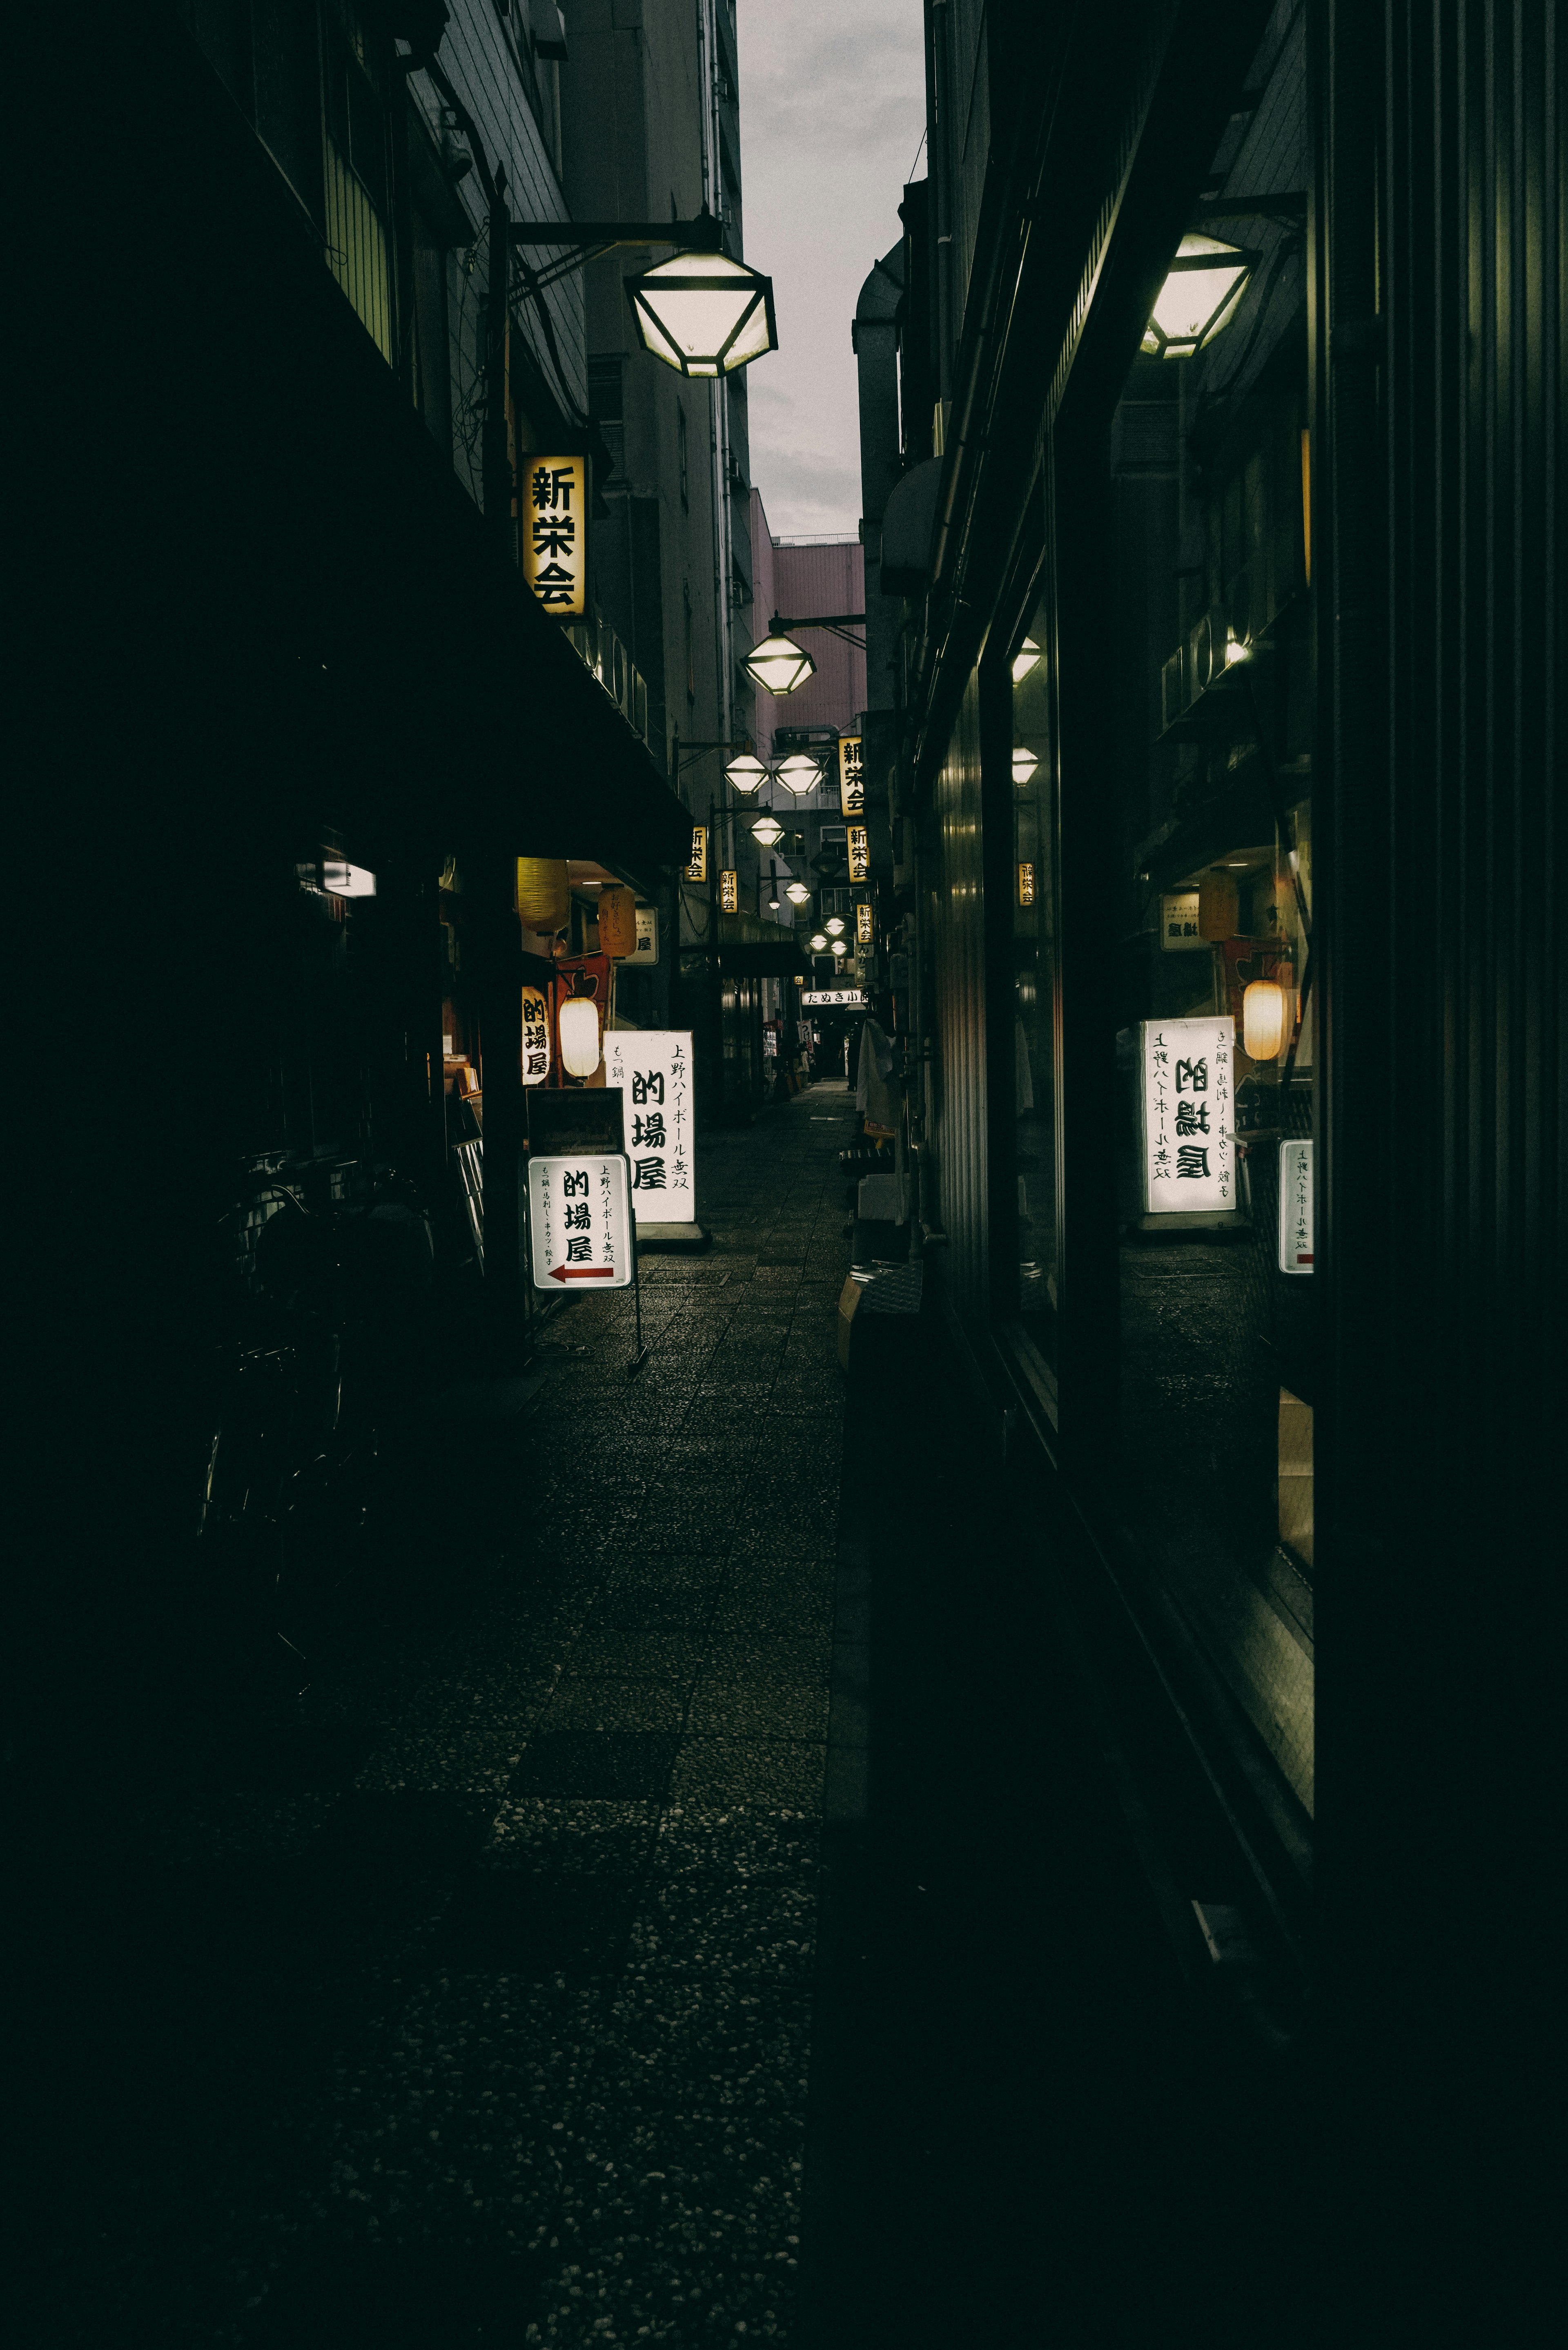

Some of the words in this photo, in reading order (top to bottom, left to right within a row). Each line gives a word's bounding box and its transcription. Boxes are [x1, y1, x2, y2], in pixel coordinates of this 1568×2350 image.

[532, 466, 575, 605] 新栄会
[844, 743, 864, 810] 新栄会
[722, 873, 734, 910] 新栄会
[851, 829, 867, 878] 新栄会
[637, 936, 651, 951] 屋
[859, 906, 871, 941] 新栄会
[523, 998, 547, 1075] 的場屋
[632, 1070, 666, 1190] 的場屋
[671, 1045, 688, 1189] 上野ハイボール無双
[541, 1167, 553, 1266] もつ鍋・馬刺し・串カツ・餃子
[564, 1171, 593, 1262] 的場屋
[600, 1166, 615, 1263] 上野ハイボール無双
